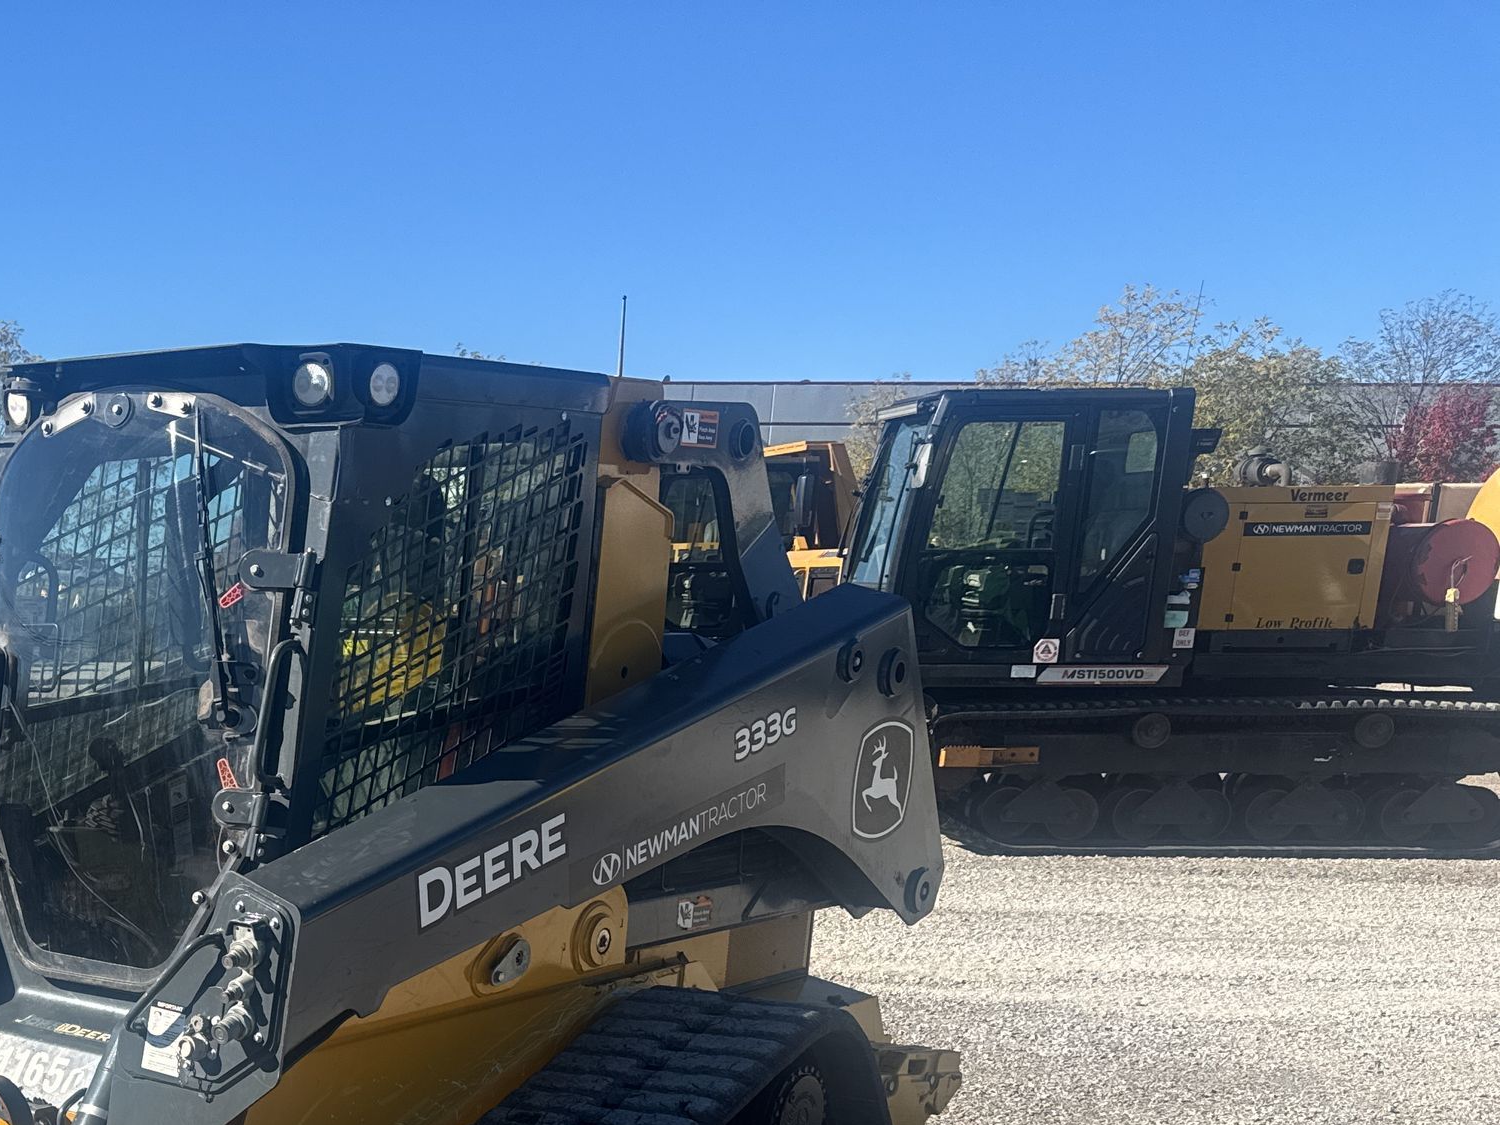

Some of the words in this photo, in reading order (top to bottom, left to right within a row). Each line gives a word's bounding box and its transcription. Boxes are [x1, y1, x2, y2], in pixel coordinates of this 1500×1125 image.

[1290, 489, 1348, 501] Vermeer
[1256, 617, 1285, 628] Low
[734, 707, 797, 761] 333G
[418, 813, 567, 929] DEERE
[64, 1023, 112, 1043] DEER
